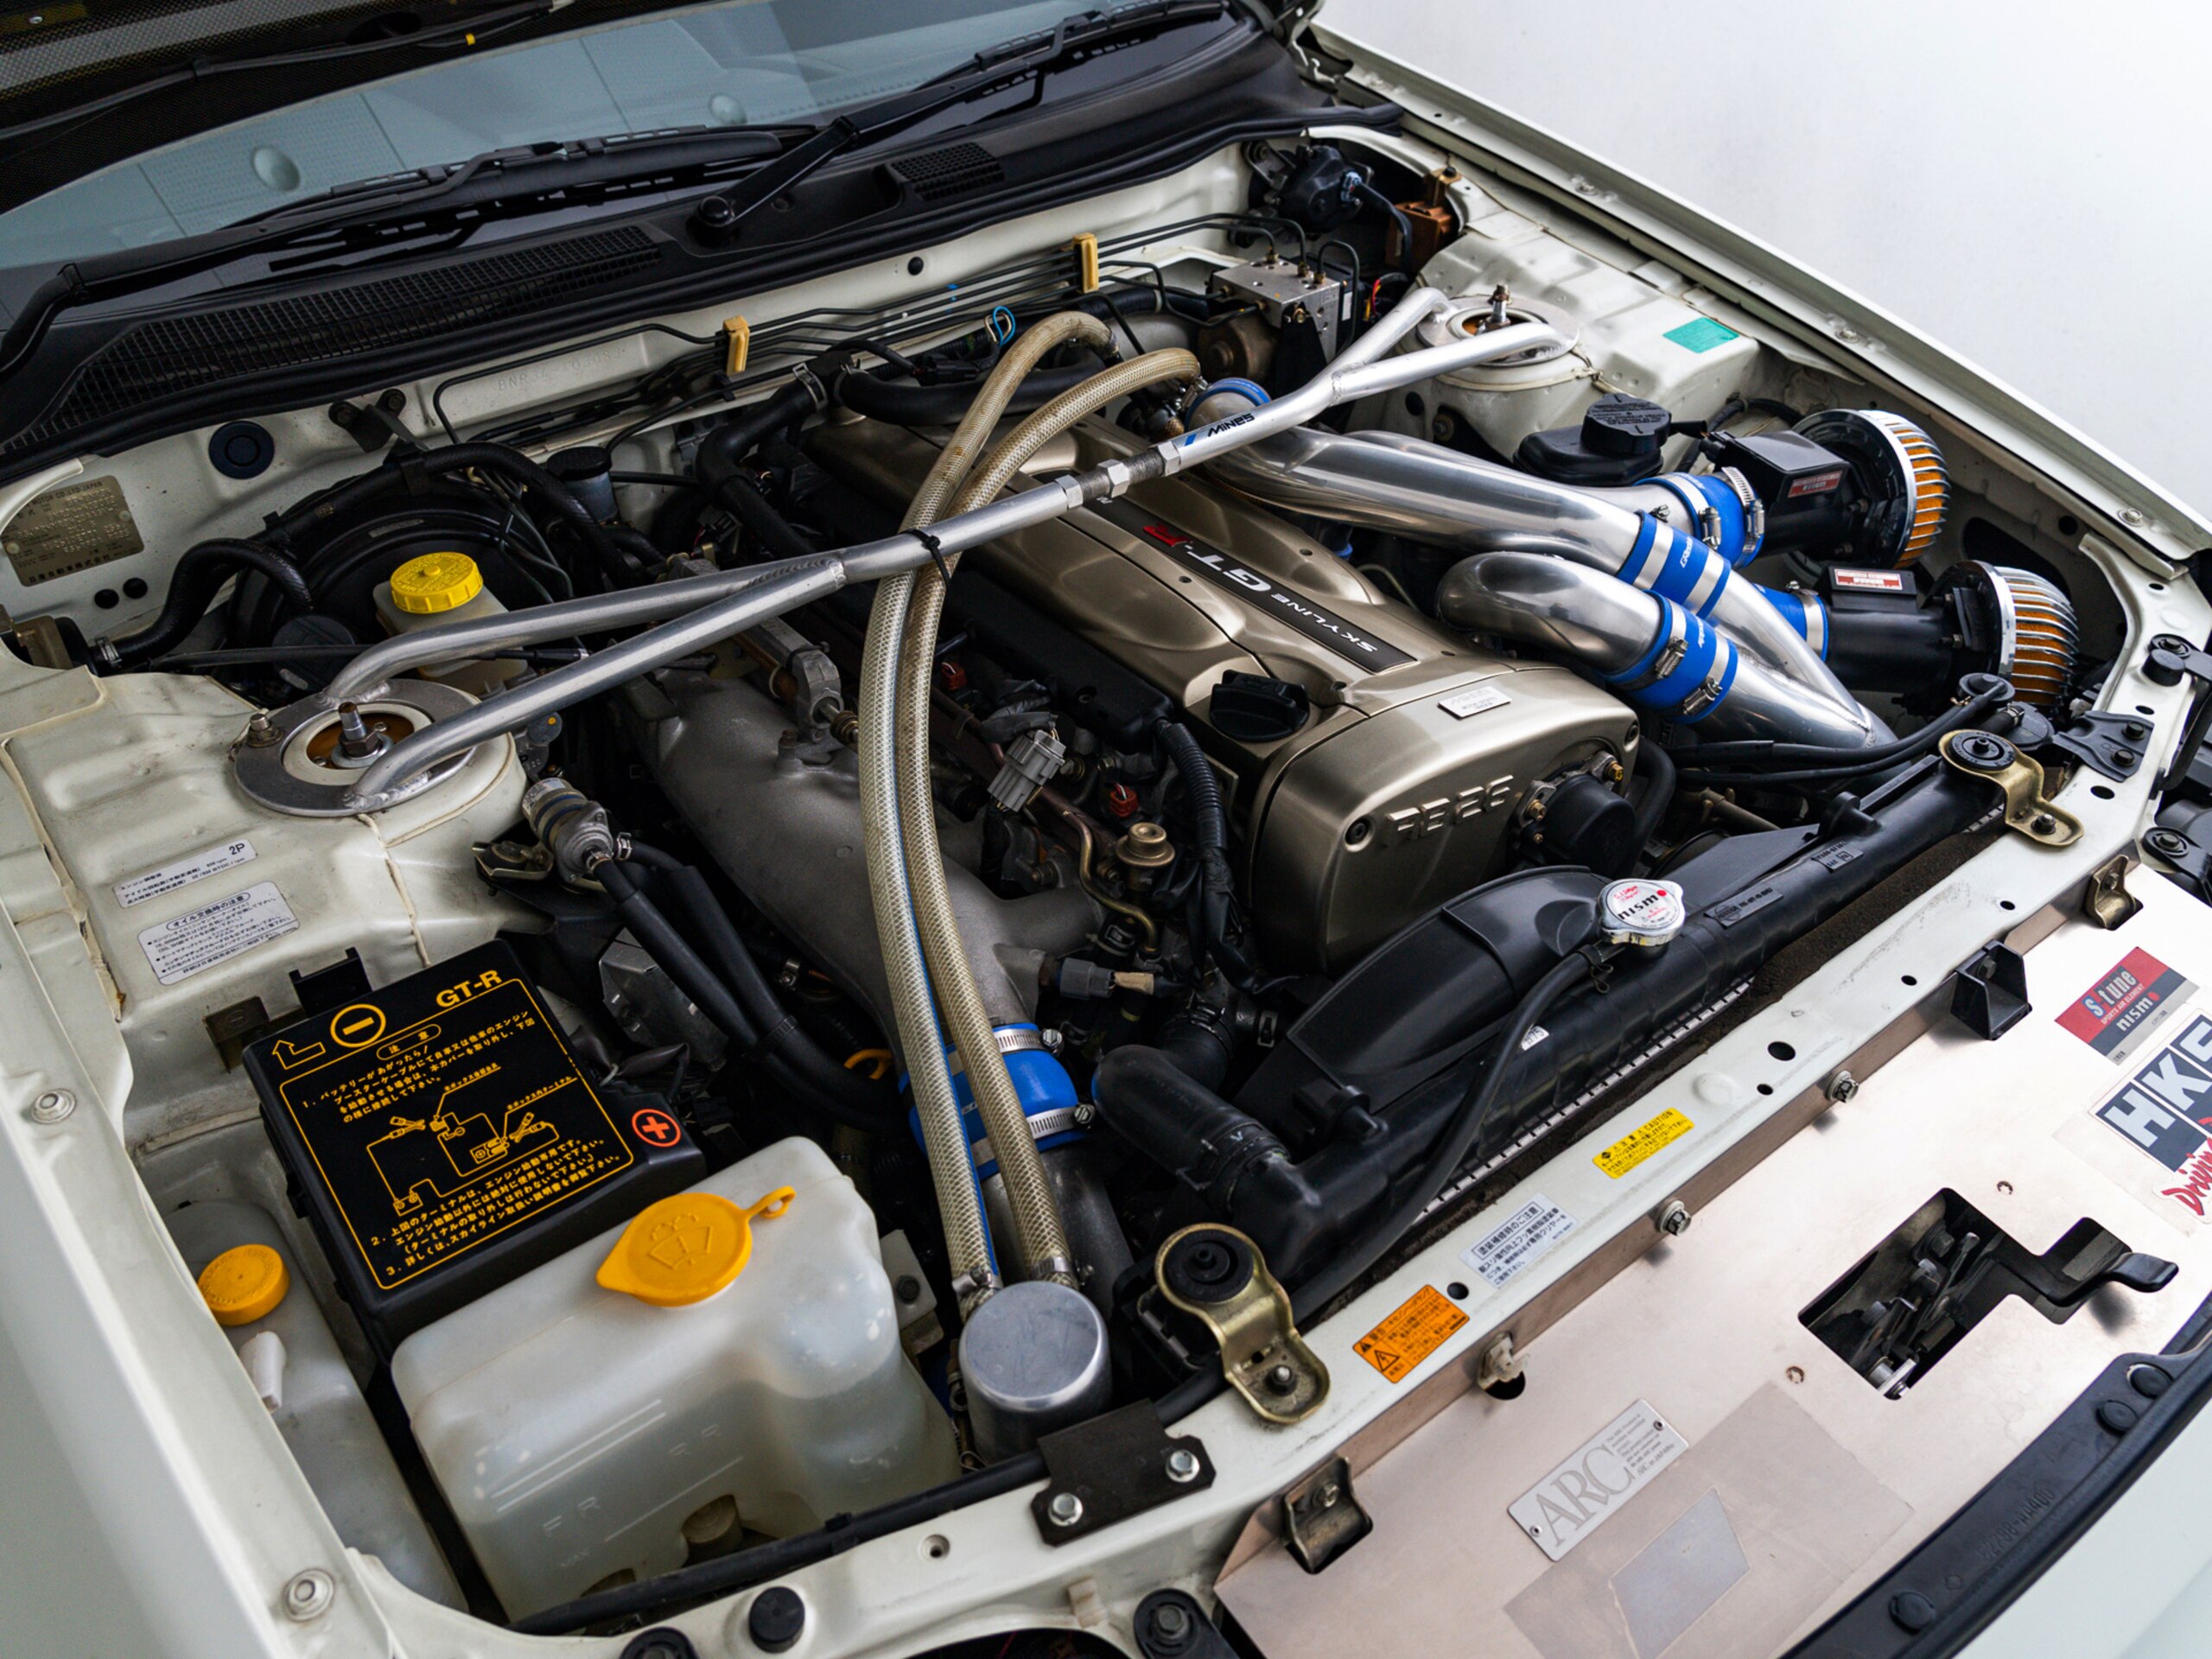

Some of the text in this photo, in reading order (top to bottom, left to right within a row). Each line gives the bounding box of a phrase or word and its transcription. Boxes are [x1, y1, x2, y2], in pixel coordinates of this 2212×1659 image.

[1142, 522, 1378, 653] SKYLINE GT-R
[1387, 775, 1514, 841] RB26
[229, 842, 245, 855] 2P
[436, 970, 503, 1007] GT-R
[1643, 1110, 1674, 1131] CAUTION
[1535, 1444, 1636, 1548] ARC
